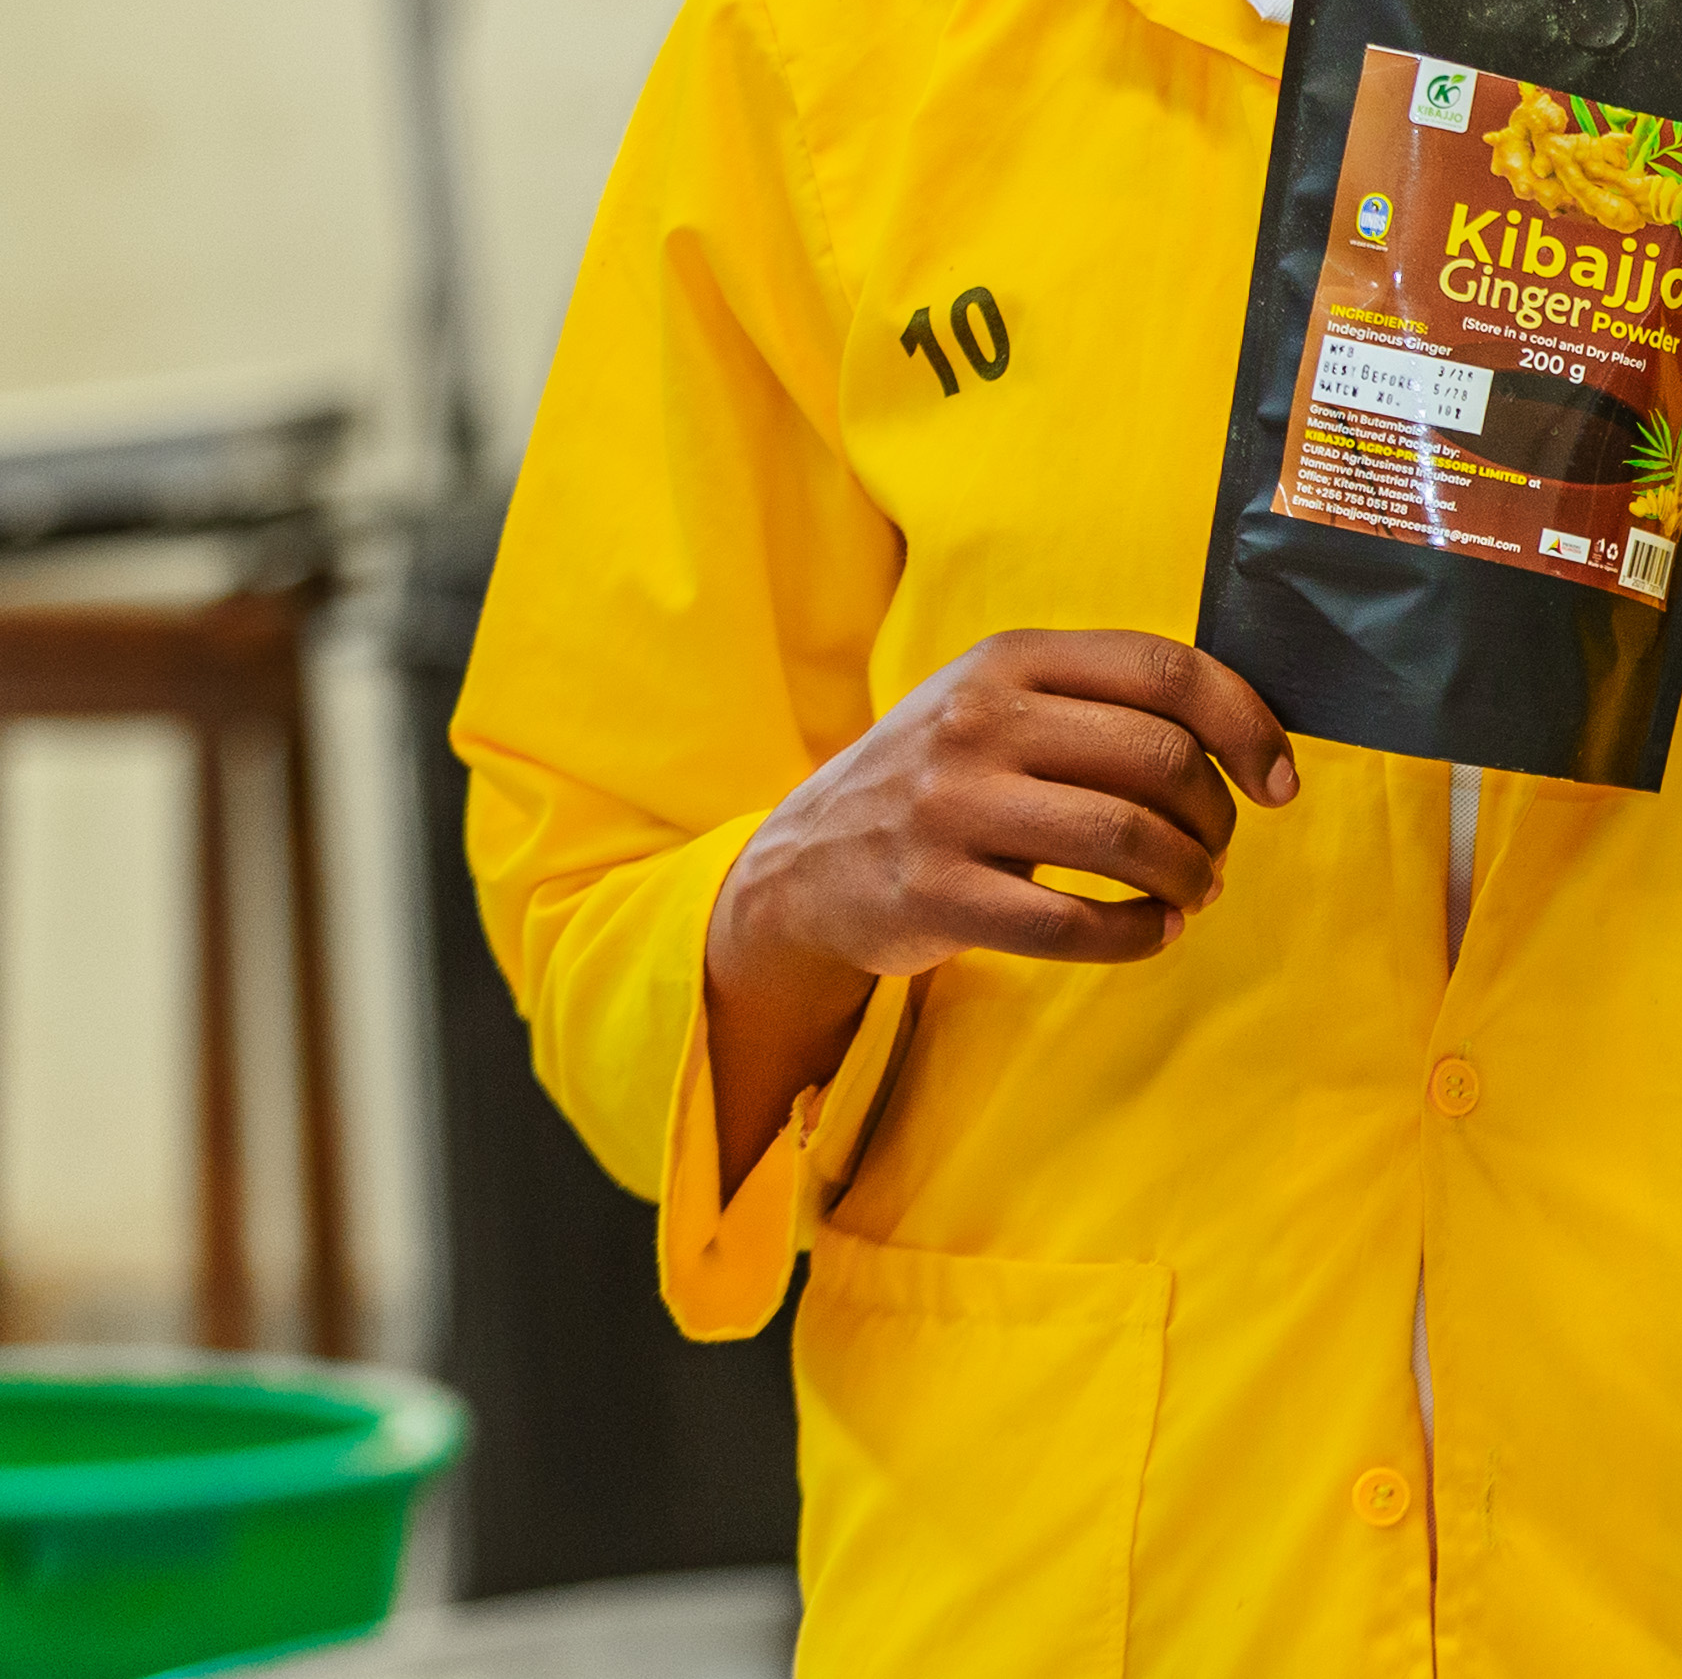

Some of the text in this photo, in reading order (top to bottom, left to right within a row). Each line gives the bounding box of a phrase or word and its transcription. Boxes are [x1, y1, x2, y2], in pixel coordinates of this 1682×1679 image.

[1417, 105, 1463, 123] KIBAJJO
[1330, 303, 1429, 335] INGREDIENTS:
[1439, 258, 1681, 354] Ginger Powder
[900, 286, 1010, 398] 10
[1327, 320, 1453, 357] Indeginous Ginger
[1462, 317, 1647, 373] (Store in a cool and Dry Place)
[1518, 347, 1586, 385] 200 g
[1309, 404, 1346, 421] Grown
[1347, 412, 1359, 423] in
[1307, 417, 1460, 459] Manufactured & Paced by:
[1300, 456, 1353, 476] Namanve
[1354, 467, 1409, 488] Industrial
[1302, 443, 1340, 459] CURAD
[1341, 451, 1414, 476] Agribusiness
[1304, 429, 1356, 449] KIBAJJO
[1478, 465, 1528, 486] LIMITED
[1528, 478, 1542, 489] at
[1292, 495, 1325, 511] Email:
[1296, 481, 1409, 515] Tel: +256 756 055 128
[1333, 477, 1377, 496] Kitemu,
[1378, 486, 1424, 504] Masaka
